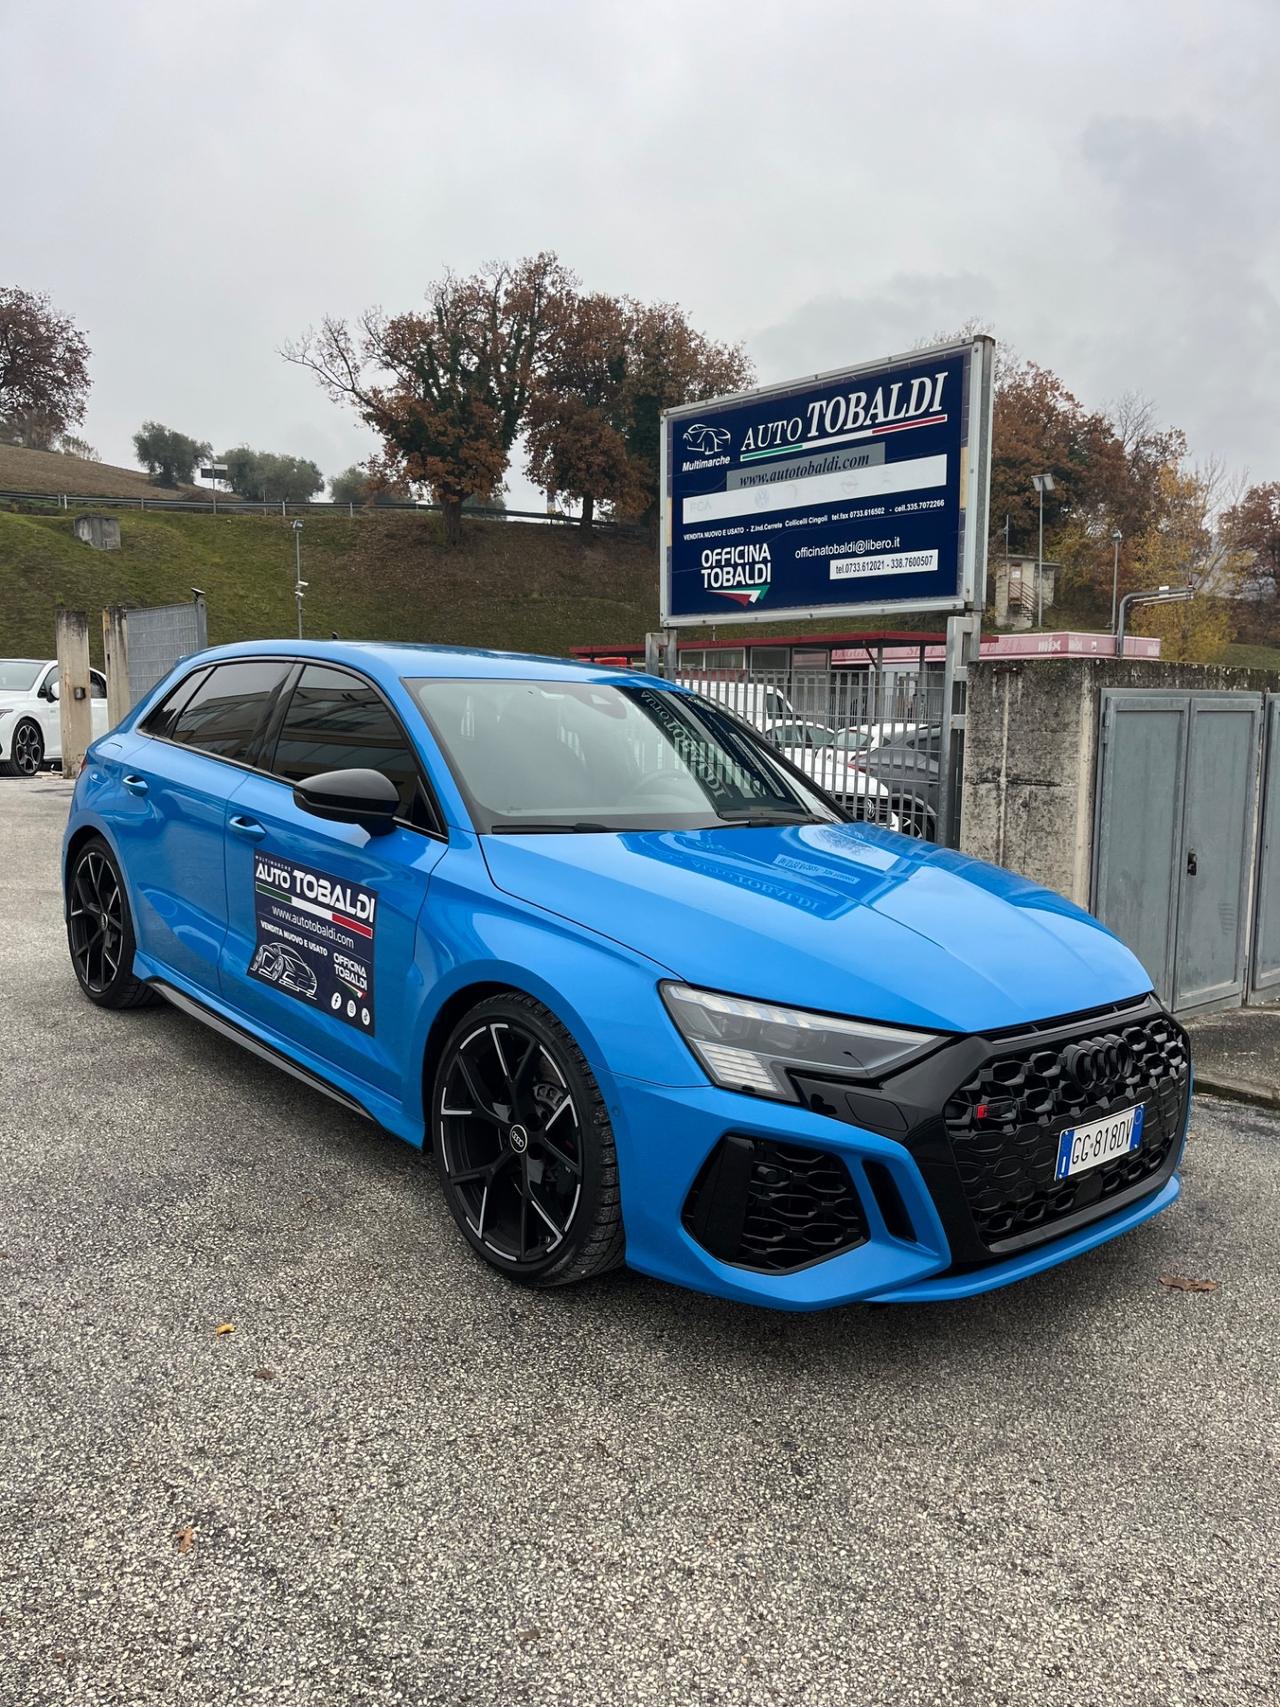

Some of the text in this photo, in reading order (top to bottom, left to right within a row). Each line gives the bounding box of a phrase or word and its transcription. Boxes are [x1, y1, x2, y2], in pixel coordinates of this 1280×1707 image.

[741, 372, 948, 451] AUTO TOBALDI
[682, 455, 730, 472] Multimarche
[739, 454, 870, 487] www.autotobaldi.com
[683, 533, 704, 541] VENDITA
[705, 530, 722, 538] NUOVO
[727, 527, 745, 535] USATO
[808, 515, 828, 525] Cingoli
[831, 512, 849, 521] tel.fax
[850, 507, 885, 518] 0733.616502
[894, 499, 945, 512] cell.335.7072266
[701, 543, 771, 568] OFFICINA
[795, 536, 901, 559] officinatobaldi@libero.it
[701, 562, 771, 588] TOBALDI
[836, 560, 885, 575] tel.0733.612021
[891, 555, 934, 569] 338.7600507
[256, 862, 376, 923] AUTO TOBALDI
[260, 920, 328, 956] VENDITA NUOVO E USATO
[272, 905, 354, 949] www.autotobaldi.com
[333, 952, 367, 978] OFFICINA
[333, 964, 367, 991] TOBALDI
